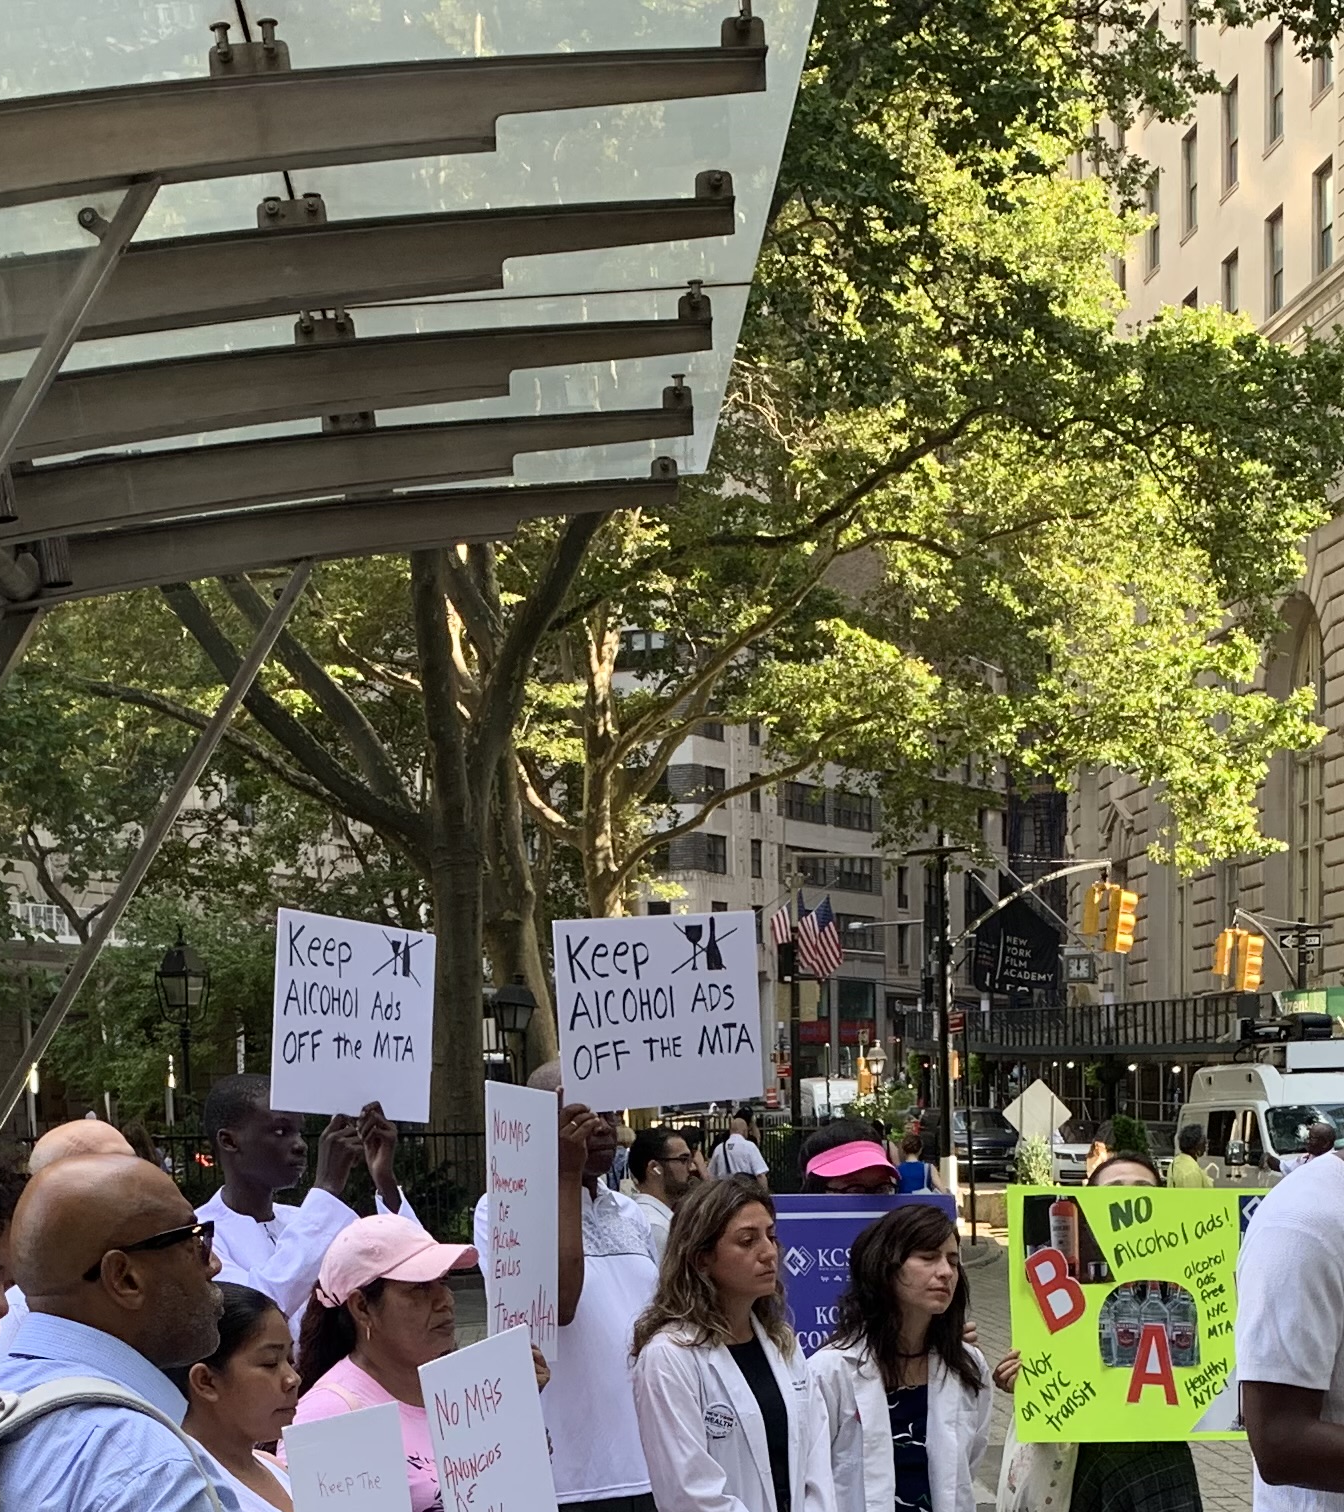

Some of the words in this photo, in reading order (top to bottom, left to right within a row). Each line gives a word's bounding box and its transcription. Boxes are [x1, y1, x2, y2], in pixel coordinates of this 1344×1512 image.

[289, 921, 352, 978] Keep
[1006, 935, 1028, 946] NEW
[1006, 946, 1032, 958] YORK
[566, 934, 649, 983] Keep
[1004, 955, 1027, 969] FILM
[1003, 968, 1054, 982] ACADEMY
[371, 991, 401, 1020] Ads
[691, 983, 735, 1012] ADS
[283, 1029, 323, 1064] OFF
[332, 1032, 362, 1060] the
[373, 1030, 414, 1062] MTA
[573, 1040, 630, 1080] OFF
[643, 1036, 682, 1062] THE
[698, 1023, 754, 1057] MTA
[1109, 1196, 1153, 1232] NO
[1194, 1206, 1234, 1240] ads!
[1184, 1249, 1225, 1279] alcohol
[1024, 1248, 1086, 1335] B
[1196, 1272, 1217, 1289] ads
[1201, 1283, 1226, 1304] free
[815, 1306, 842, 1326] KC
[1207, 1301, 1228, 1321] NYC
[1207, 1320, 1233, 1339] MTA
[1022, 1351, 1052, 1386] Not
[1126, 1323, 1180, 1406] A
[1184, 1357, 1229, 1397] Healthy
[464, 1377, 503, 1429] MAS
[1021, 1401, 1041, 1422] on
[1039, 1371, 1071, 1407] NYC
[1044, 1380, 1097, 1432] transit
[1193, 1378, 1231, 1409] NYC!
[704, 1415, 733, 1428] HEALTH
[443, 1443, 502, 1491] ANUNCIOS
[317, 1471, 355, 1497] Keep
[356, 1471, 382, 1490] The
